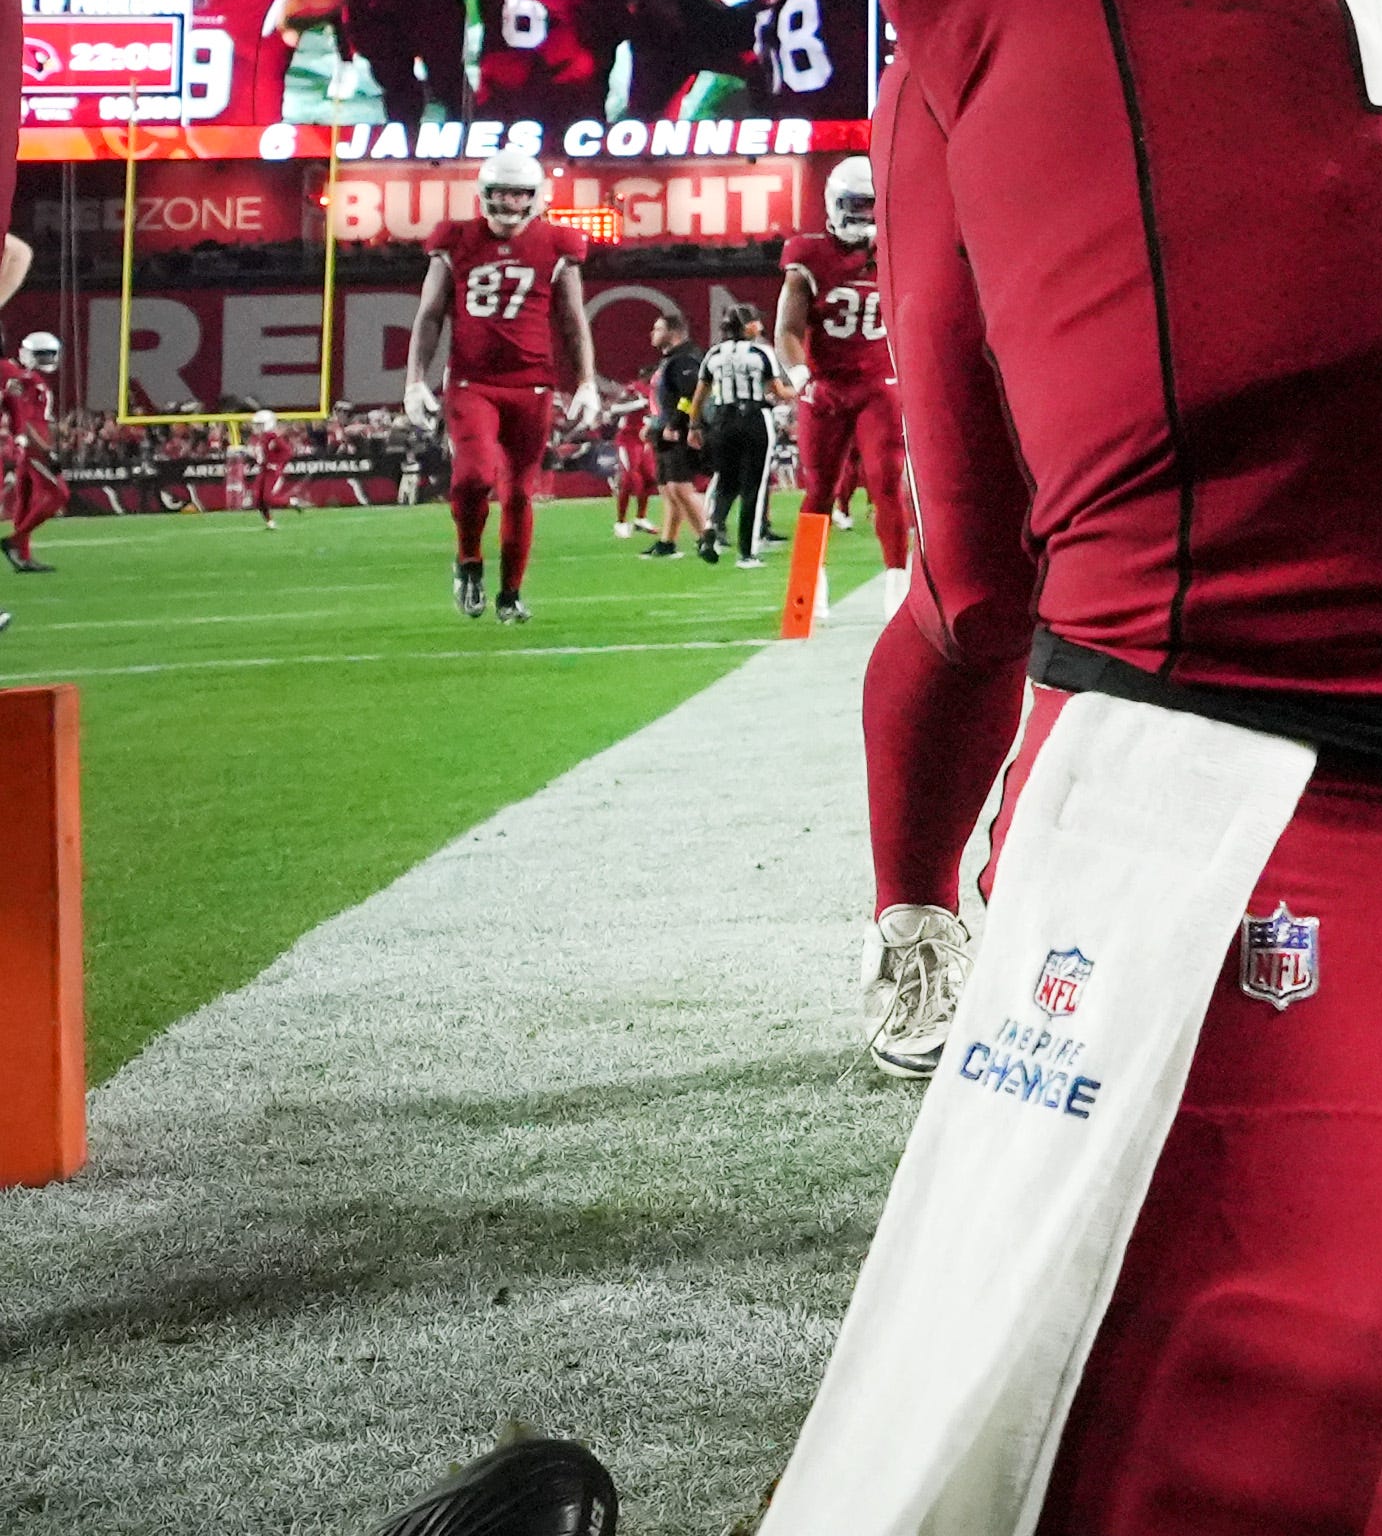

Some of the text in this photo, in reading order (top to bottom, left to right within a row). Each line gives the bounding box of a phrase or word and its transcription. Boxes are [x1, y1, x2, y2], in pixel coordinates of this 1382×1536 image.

[259, 118, 812, 160] 6 JAMES CONNER
[546, 175, 782, 238] IGHT
[465, 265, 536, 320] 87
[1254, 952, 1310, 991] NFL
[1038, 974, 1078, 1013] NFL
